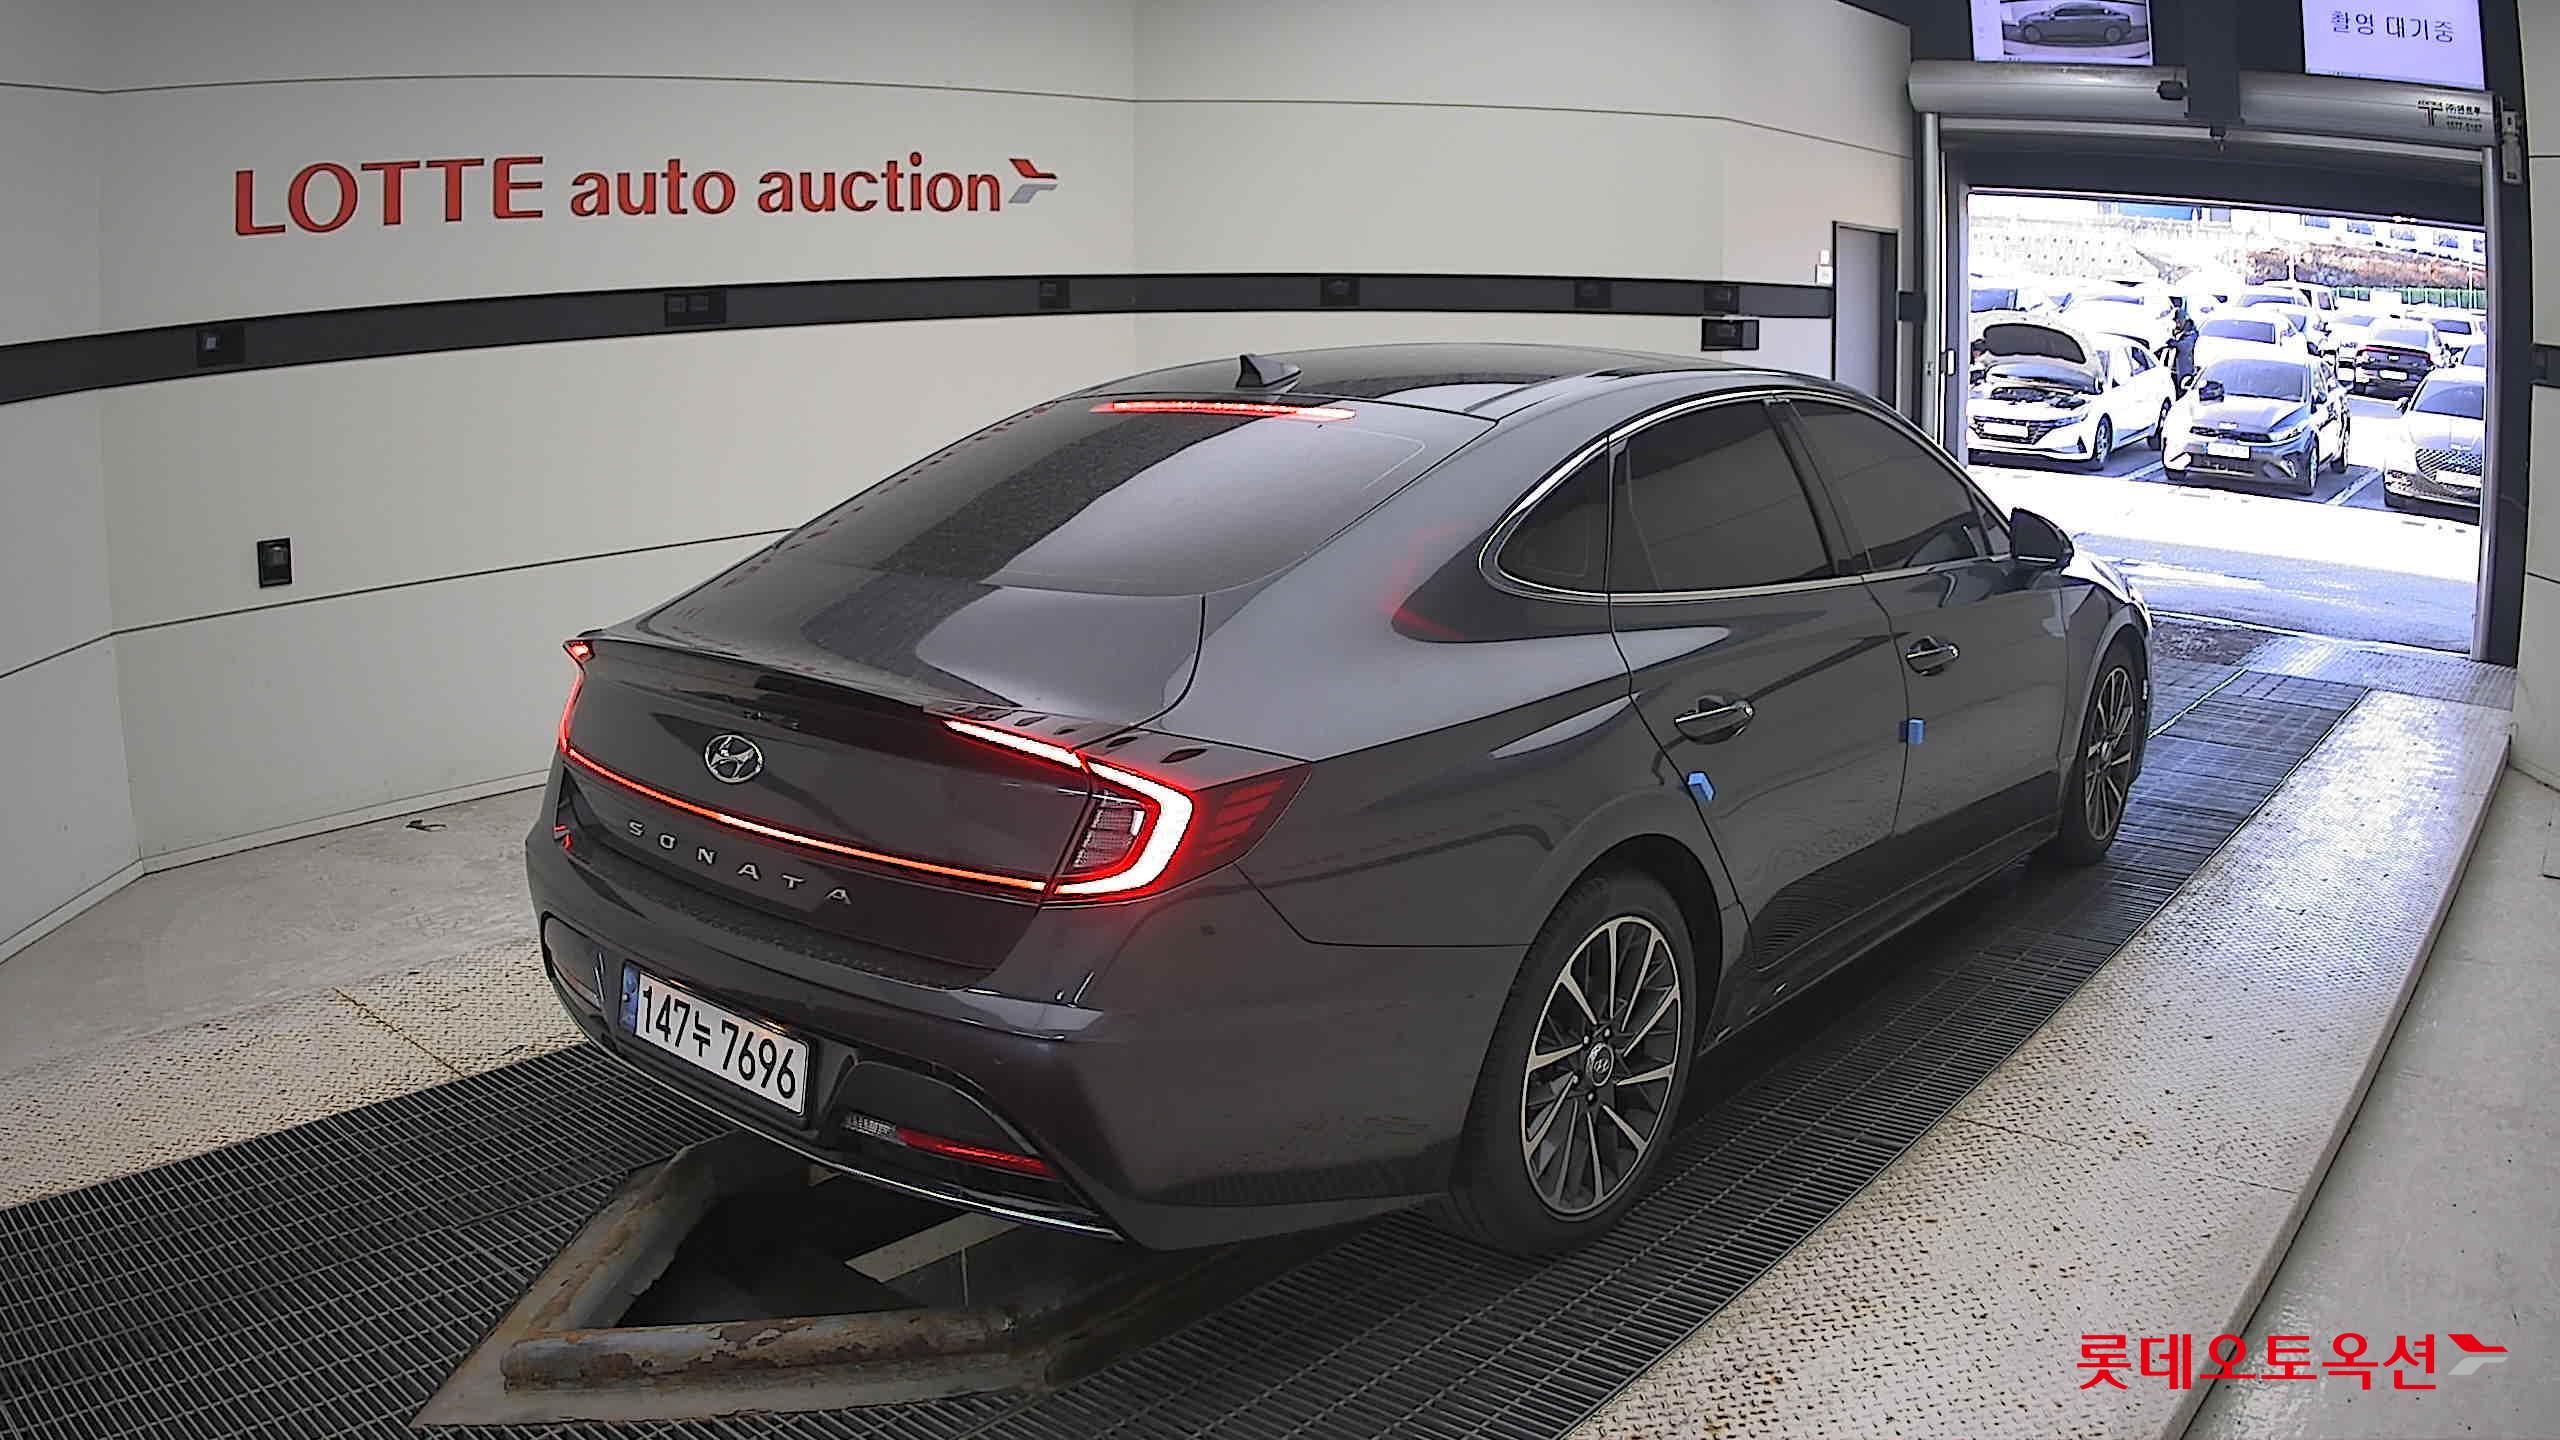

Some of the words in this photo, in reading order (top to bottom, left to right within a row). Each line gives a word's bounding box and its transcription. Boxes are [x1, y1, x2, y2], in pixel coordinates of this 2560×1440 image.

[2331, 10, 2374, 36] 촬영
[2386, 16, 2454, 43] 대기중
[235, 156, 543, 236] LOTTE
[571, 158, 736, 216] auto
[758, 152, 1000, 213] auction
[628, 819, 852, 905] SONATA
[720, 1019, 796, 1099] 7696
